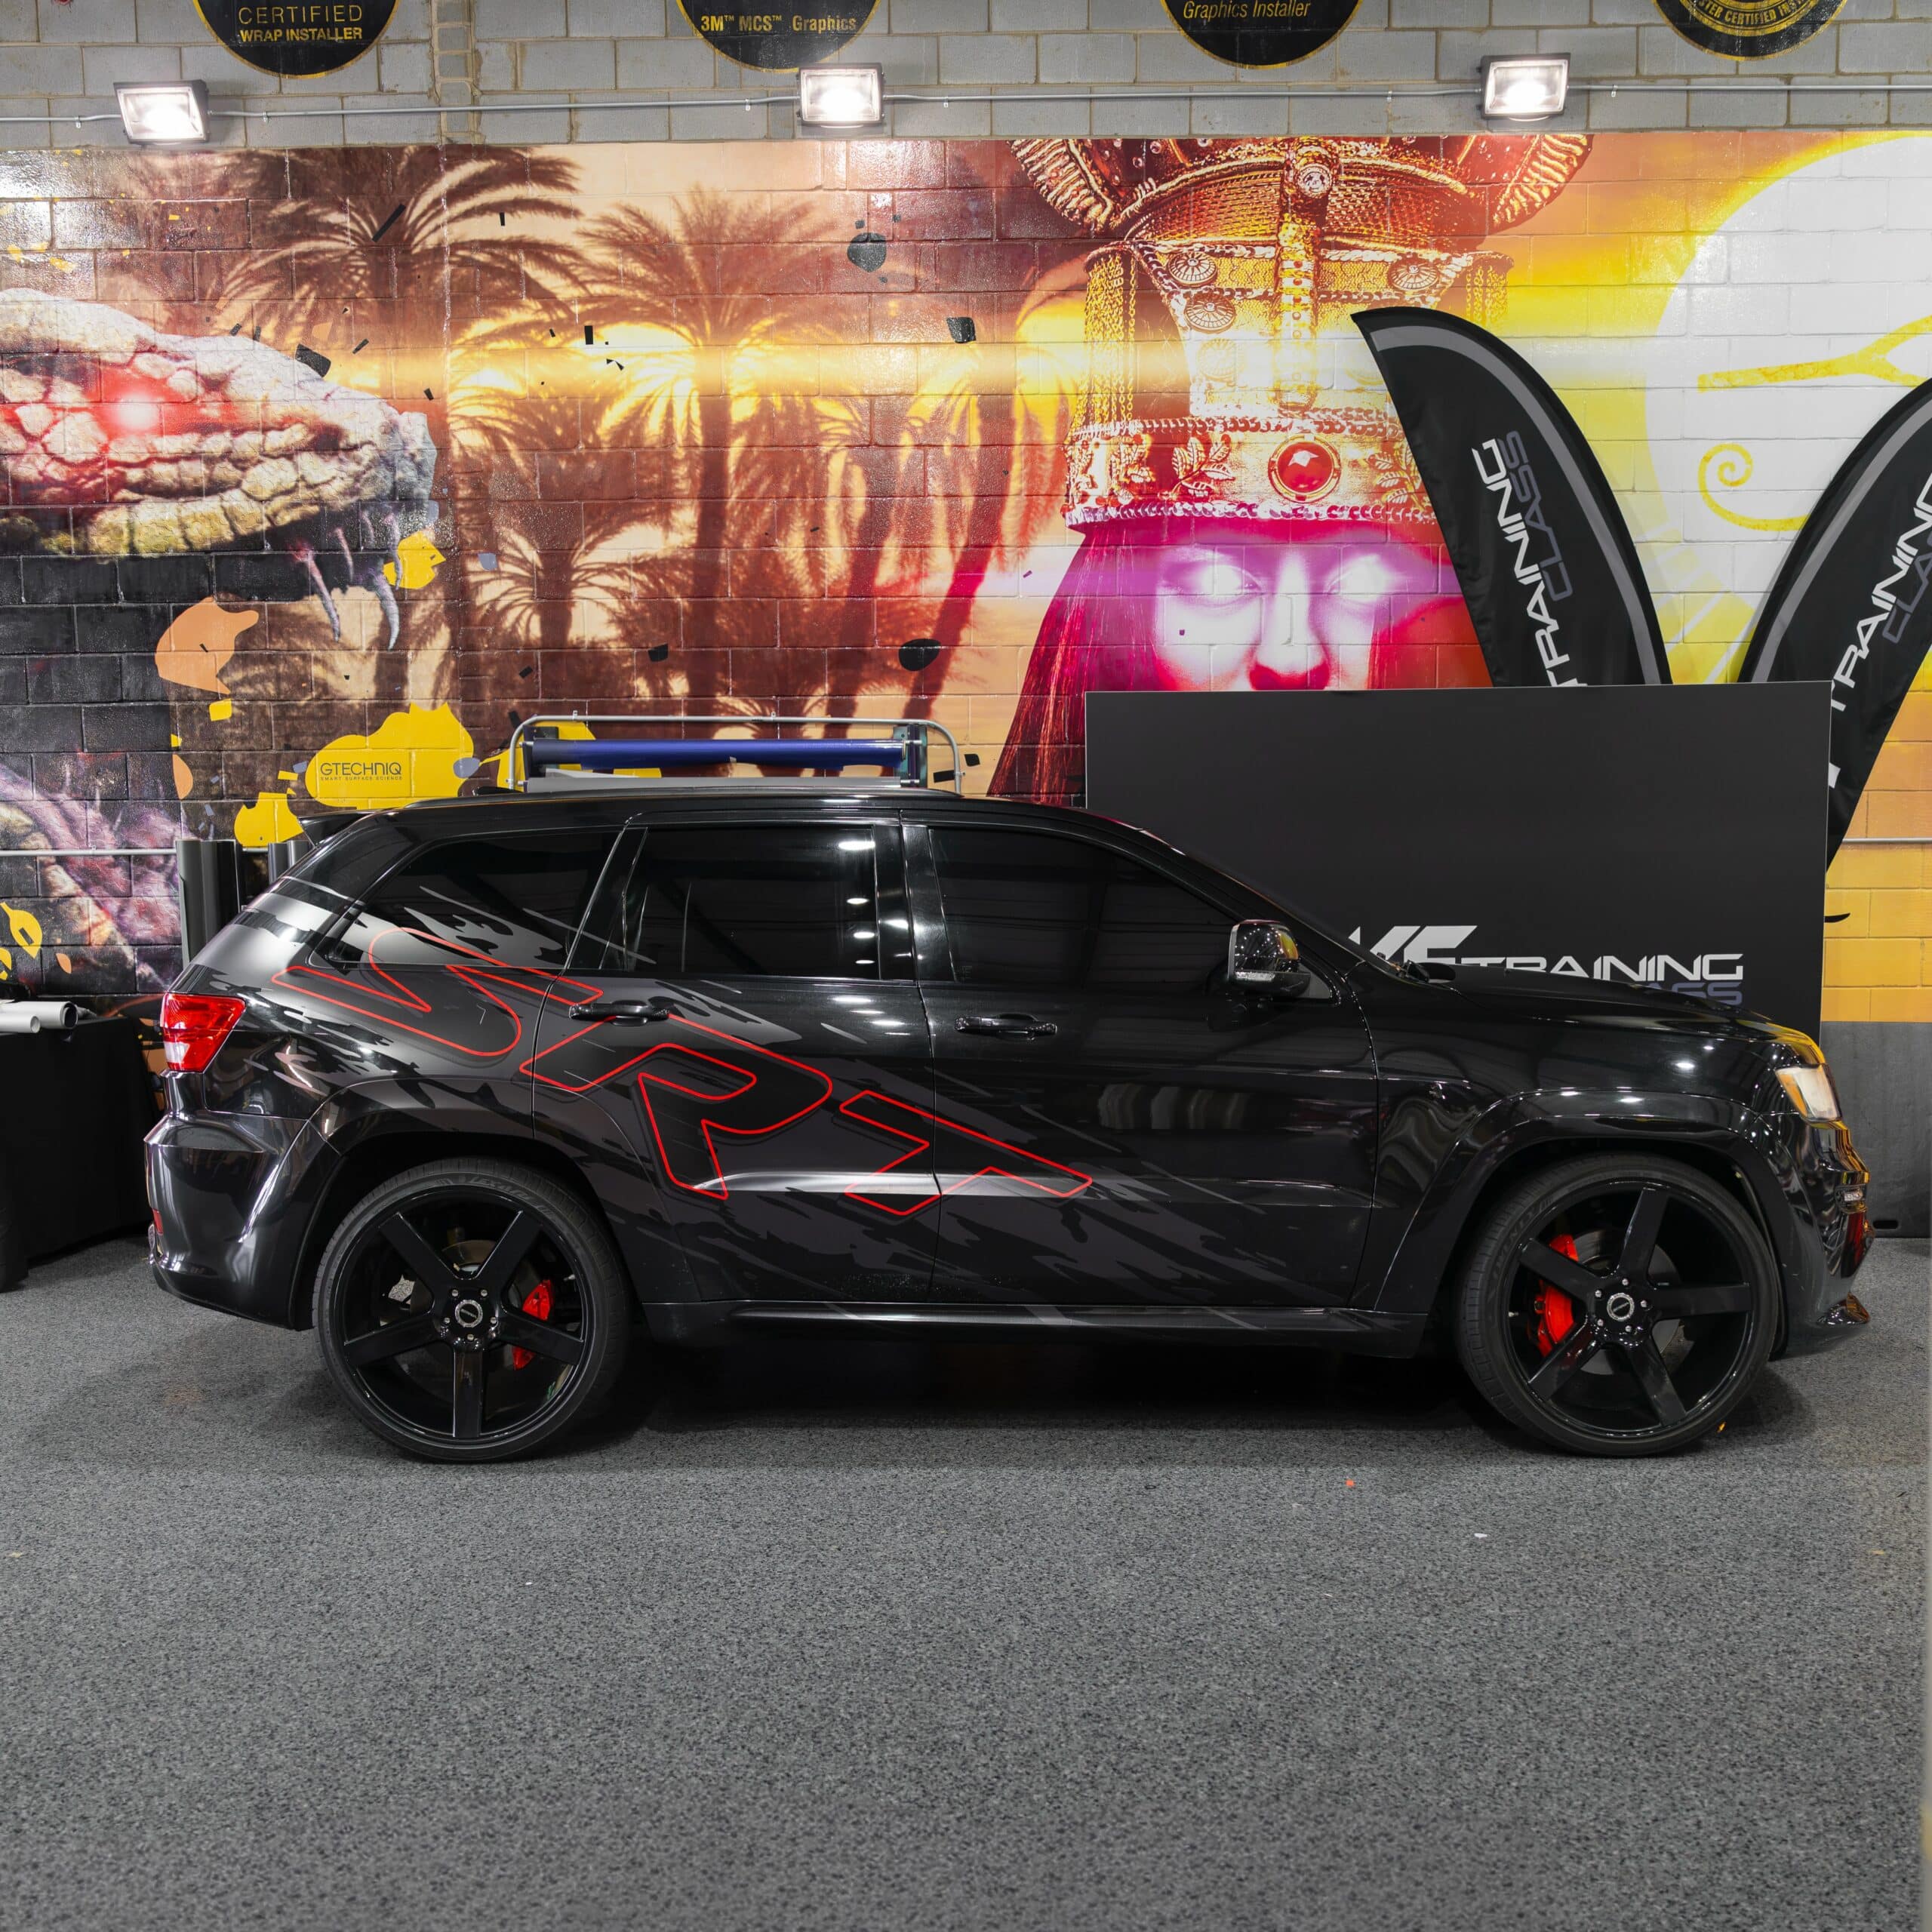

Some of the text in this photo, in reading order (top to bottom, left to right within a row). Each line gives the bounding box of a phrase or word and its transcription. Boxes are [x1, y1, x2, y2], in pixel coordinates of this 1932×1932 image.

[238, 5, 362, 24] CERTIFIED
[1183, 0, 1311, 22] Graphics Installer
[1724, 8, 1777, 25] CERTIFIED
[792, 15, 856, 33] Graphics
[240, 27, 362, 42] WRAP INSTALLER
[1497, 430, 1574, 601] CLASS
[320, 762, 402, 775] GTECHNIQ
